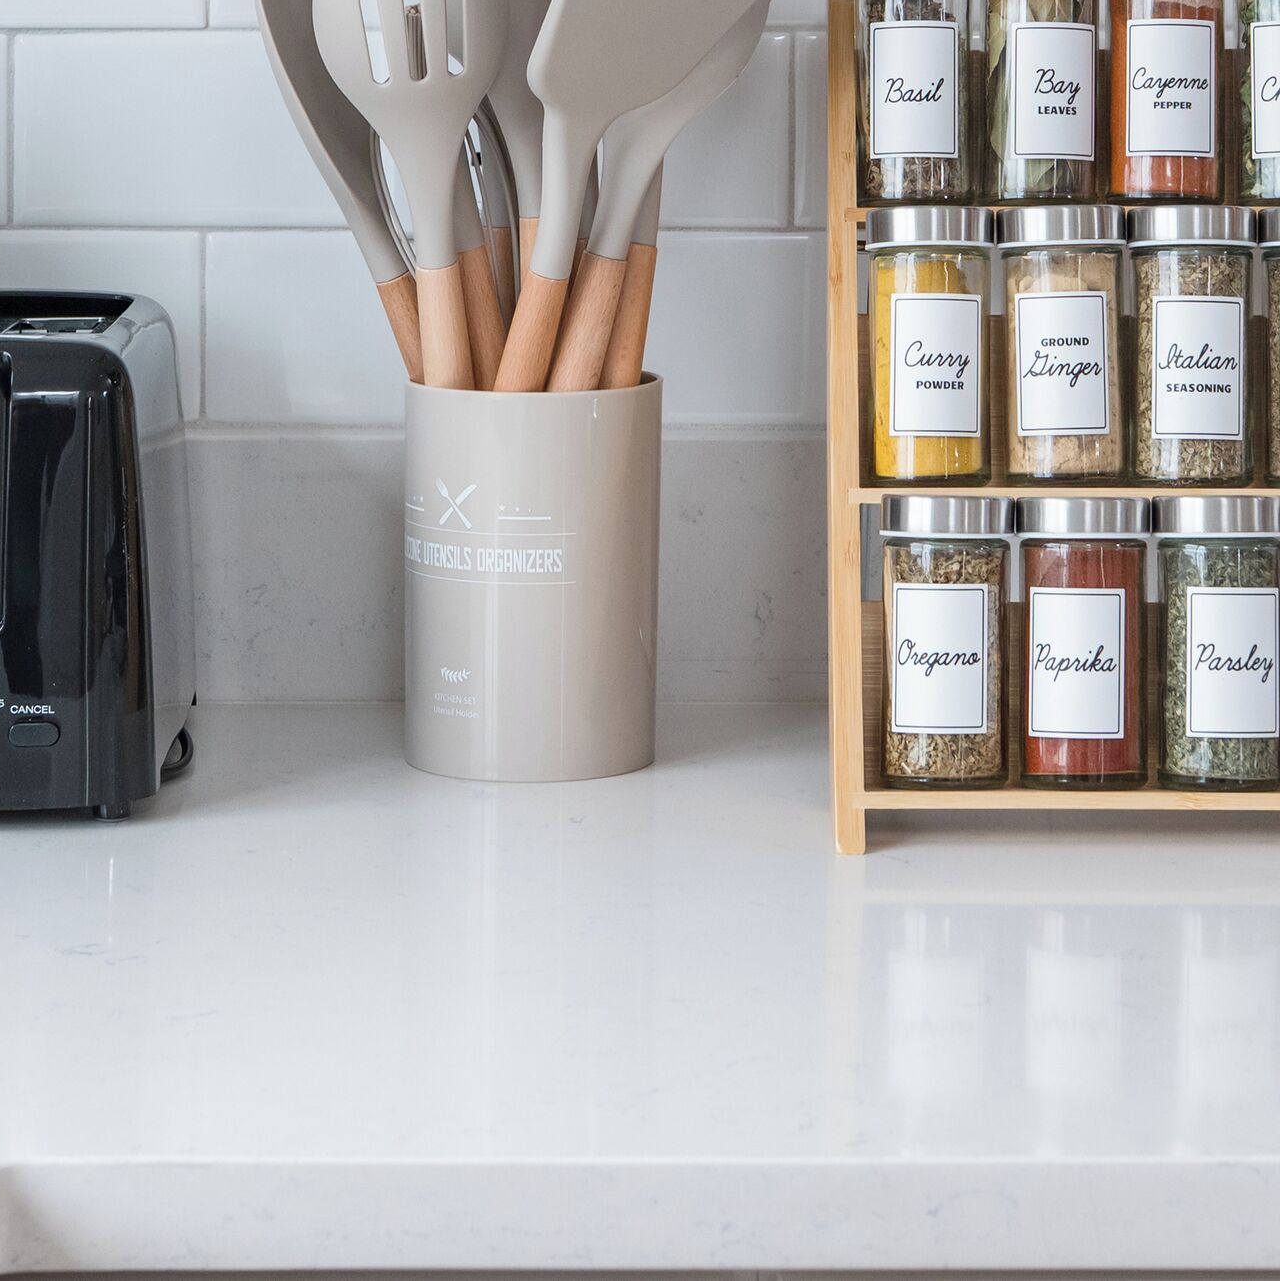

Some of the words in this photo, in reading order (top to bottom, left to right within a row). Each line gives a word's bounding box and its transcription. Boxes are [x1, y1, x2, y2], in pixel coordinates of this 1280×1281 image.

[884, 77, 945, 104] Basil
[1035, 68, 1081, 105] Bay
[1132, 66, 1209, 99] Cayenne
[1037, 105, 1078, 117] LEAVES
[1153, 101, 1193, 110] PEPPER
[1040, 336, 1090, 347] GROUND
[1158, 342, 1239, 371] Italian
[905, 340, 970, 379] Curry
[1023, 349, 1103, 387] Ginger
[916, 379, 965, 390] POWDER
[1166, 383, 1232, 394] SEASONING
[423, 541, 471, 571] UTENSILS
[477, 549, 562, 573] ORGANIZERS
[897, 638, 980, 677] Oregano
[1034, 643, 1118, 682] Paprika
[1194, 643, 1274, 684] Parsley
[10, 705, 55, 715] CANCEL
